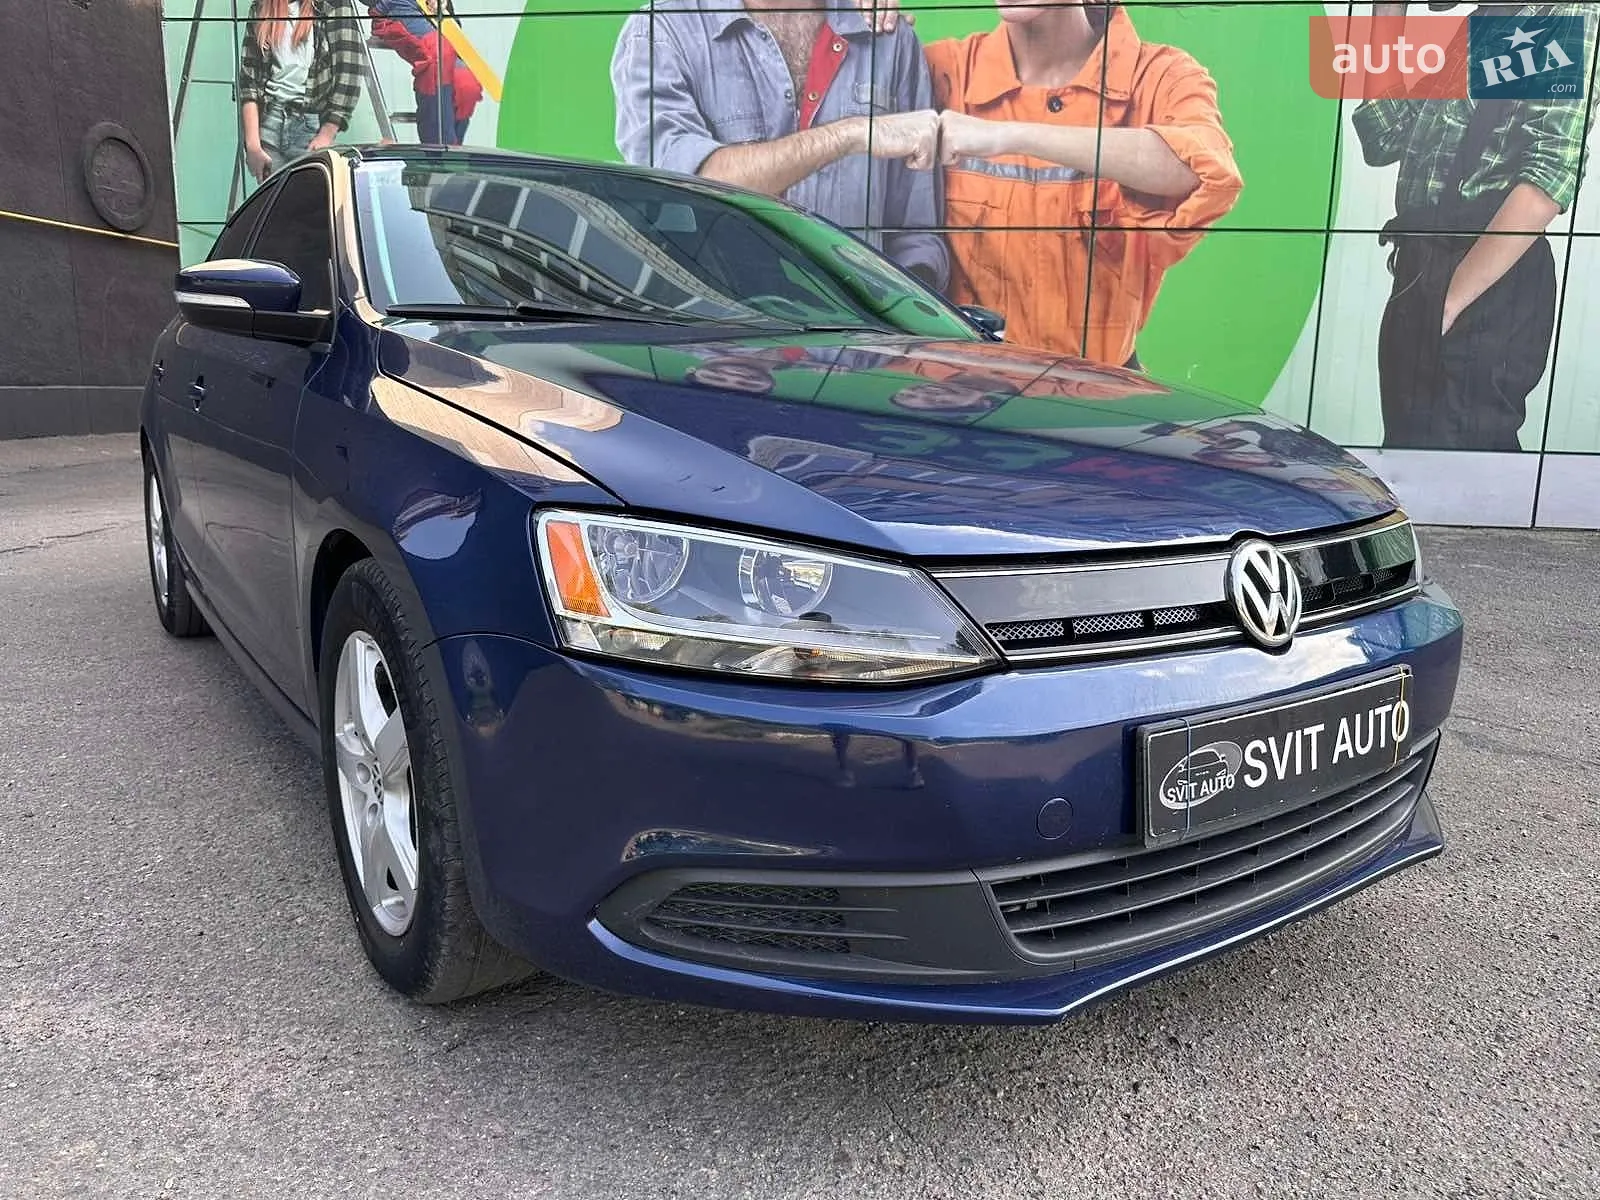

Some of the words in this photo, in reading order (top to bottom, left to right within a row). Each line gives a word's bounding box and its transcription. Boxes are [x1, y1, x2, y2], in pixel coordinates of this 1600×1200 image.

[1243, 723, 1325, 788] SVIT
[1332, 700, 1410, 764] AUTO
[1167, 780, 1197, 804] SVIT
[1200, 773, 1236, 798] AUTO
